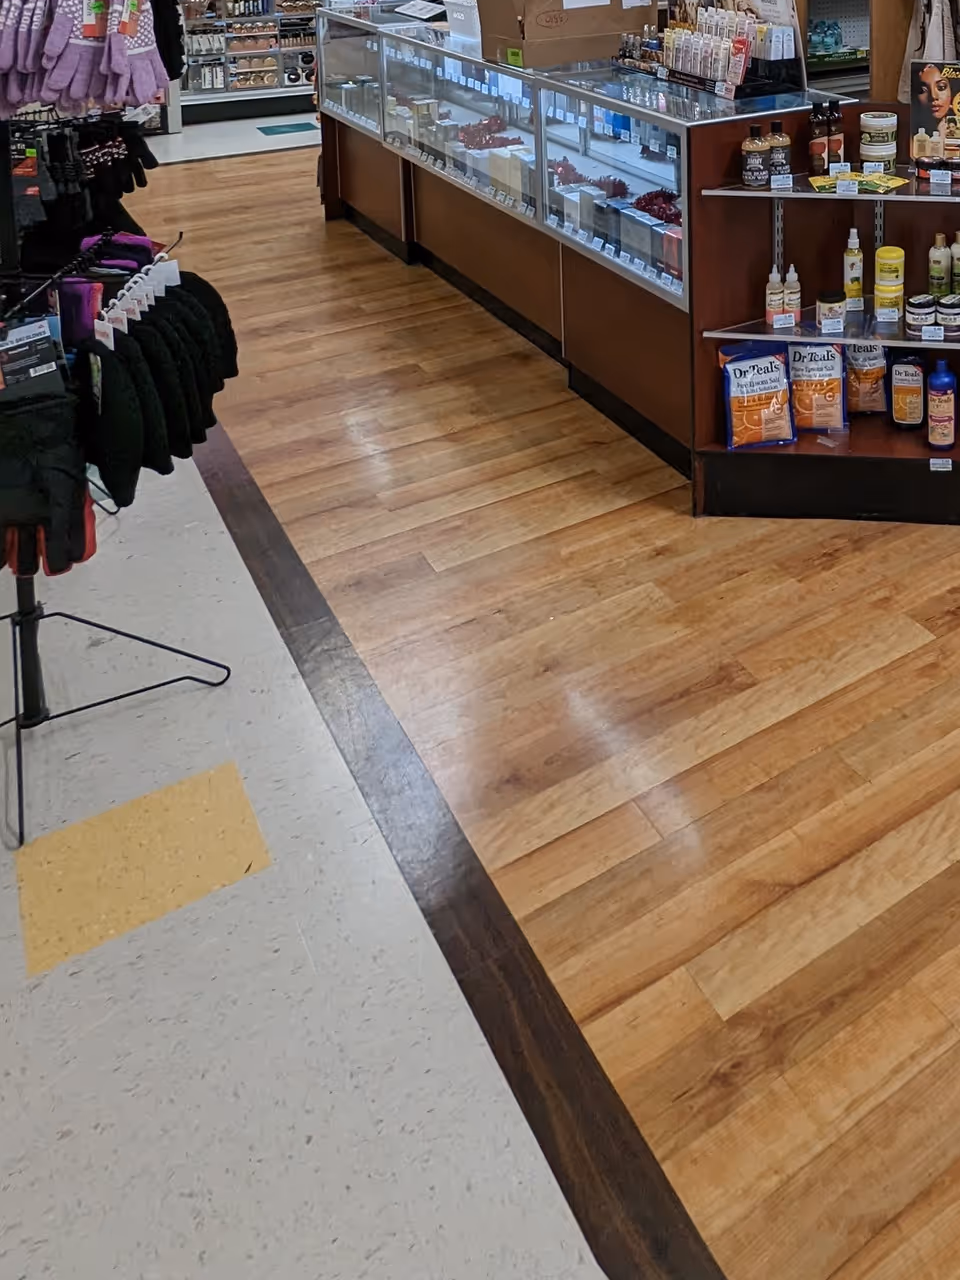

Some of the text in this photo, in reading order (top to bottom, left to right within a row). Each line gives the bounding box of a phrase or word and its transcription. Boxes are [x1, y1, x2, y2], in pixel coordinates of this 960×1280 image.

[793, 350, 836, 362] Dr Teal's
[733, 360, 780, 379] Dr Teal's
